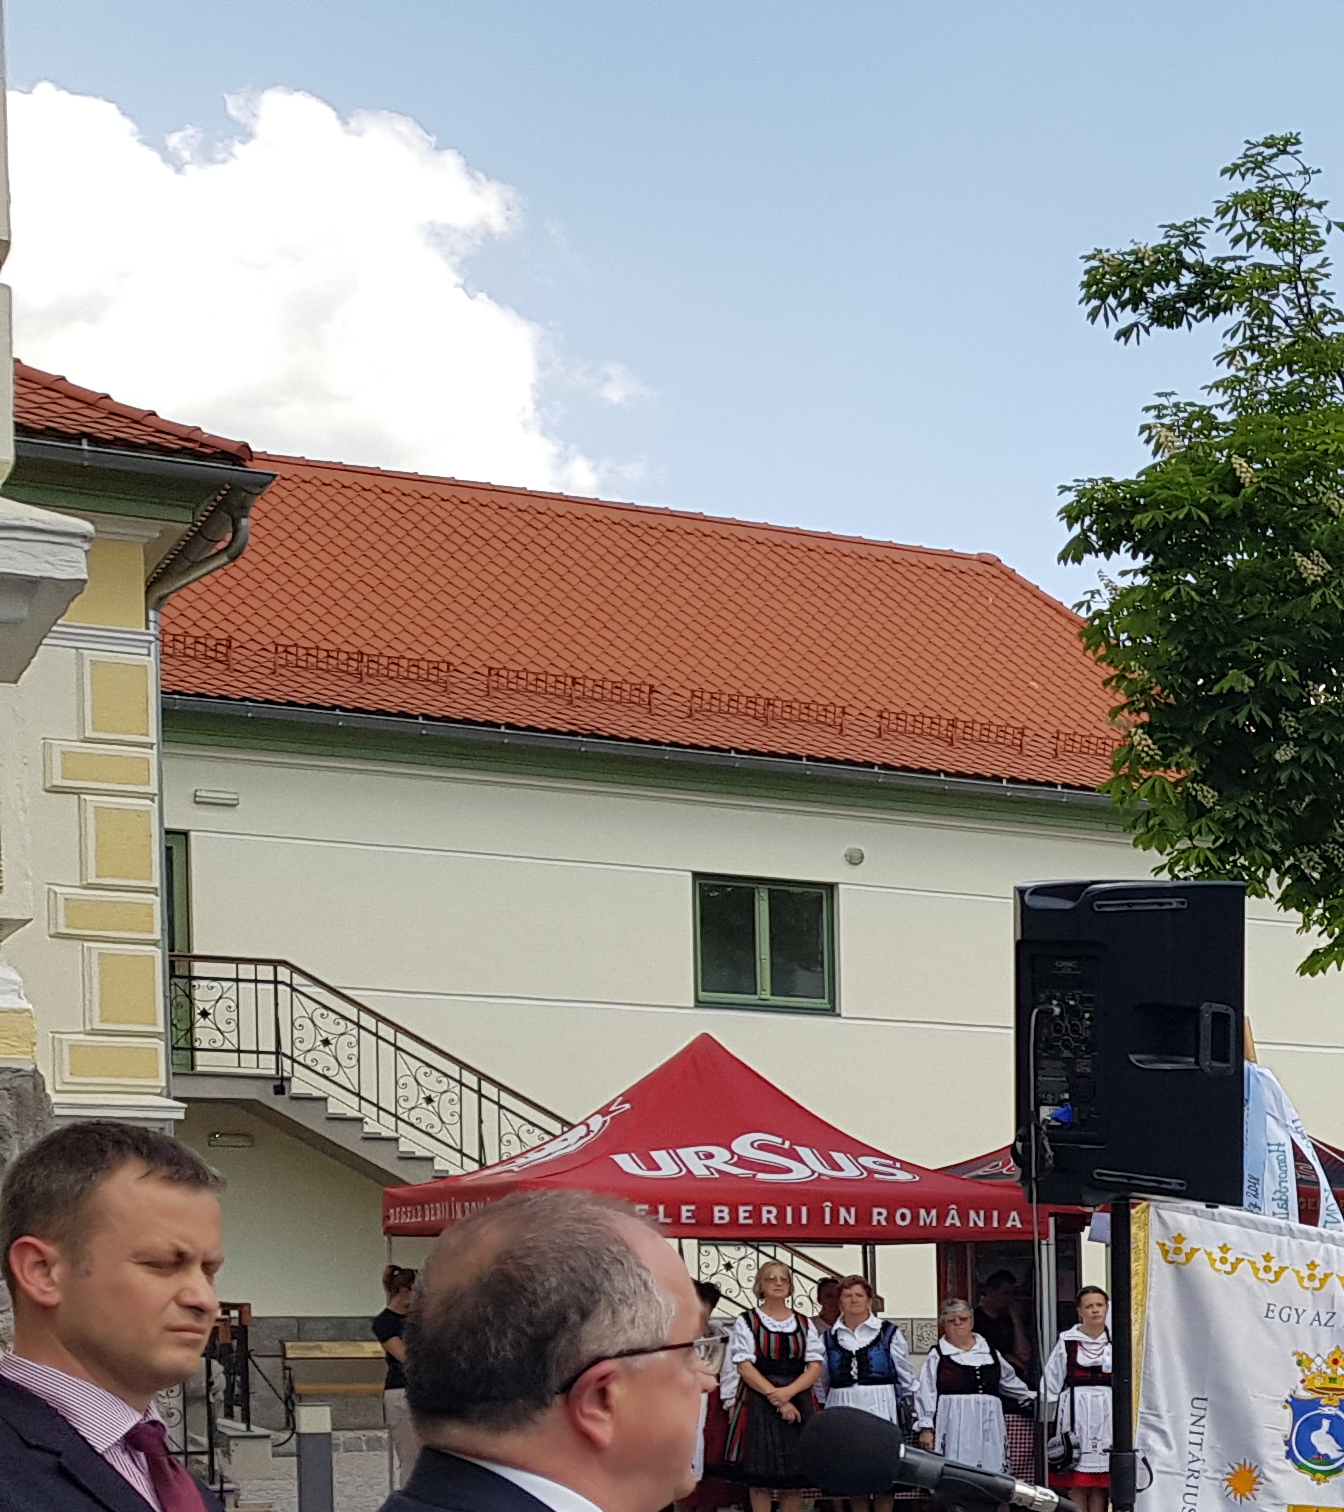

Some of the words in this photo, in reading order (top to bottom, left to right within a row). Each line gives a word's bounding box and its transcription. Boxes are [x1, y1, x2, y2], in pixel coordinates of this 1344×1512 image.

[610, 1132, 920, 1183] URSUS
[713, 1204, 809, 1226] BERII
[822, 1201, 857, 1226] ÎN
[871, 1204, 1023, 1228] ROMÂNIA
[1263, 1302, 1307, 1325] EGY
[1309, 1310, 1337, 1328] AZ
